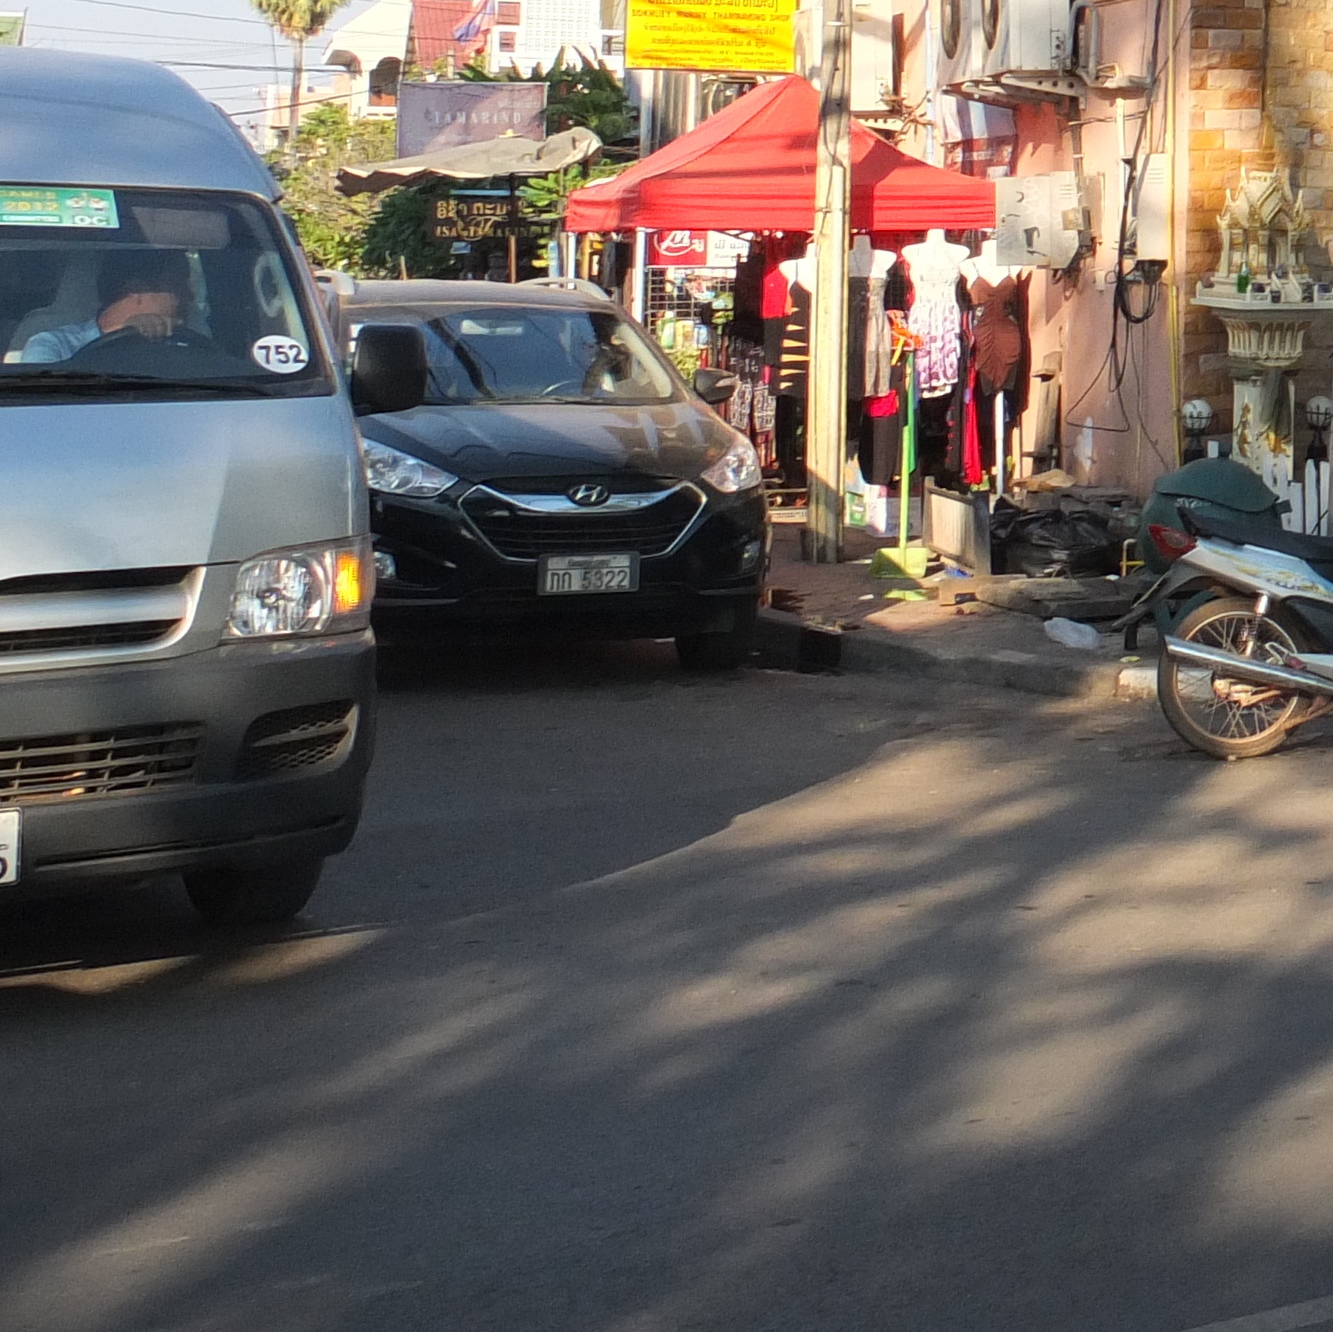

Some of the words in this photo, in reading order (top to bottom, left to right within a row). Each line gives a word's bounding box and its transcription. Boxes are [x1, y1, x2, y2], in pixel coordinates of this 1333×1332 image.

[434, 110, 522, 125] TAMARIND
[73, 214, 109, 227] OC
[256, 343, 307, 365] 752
